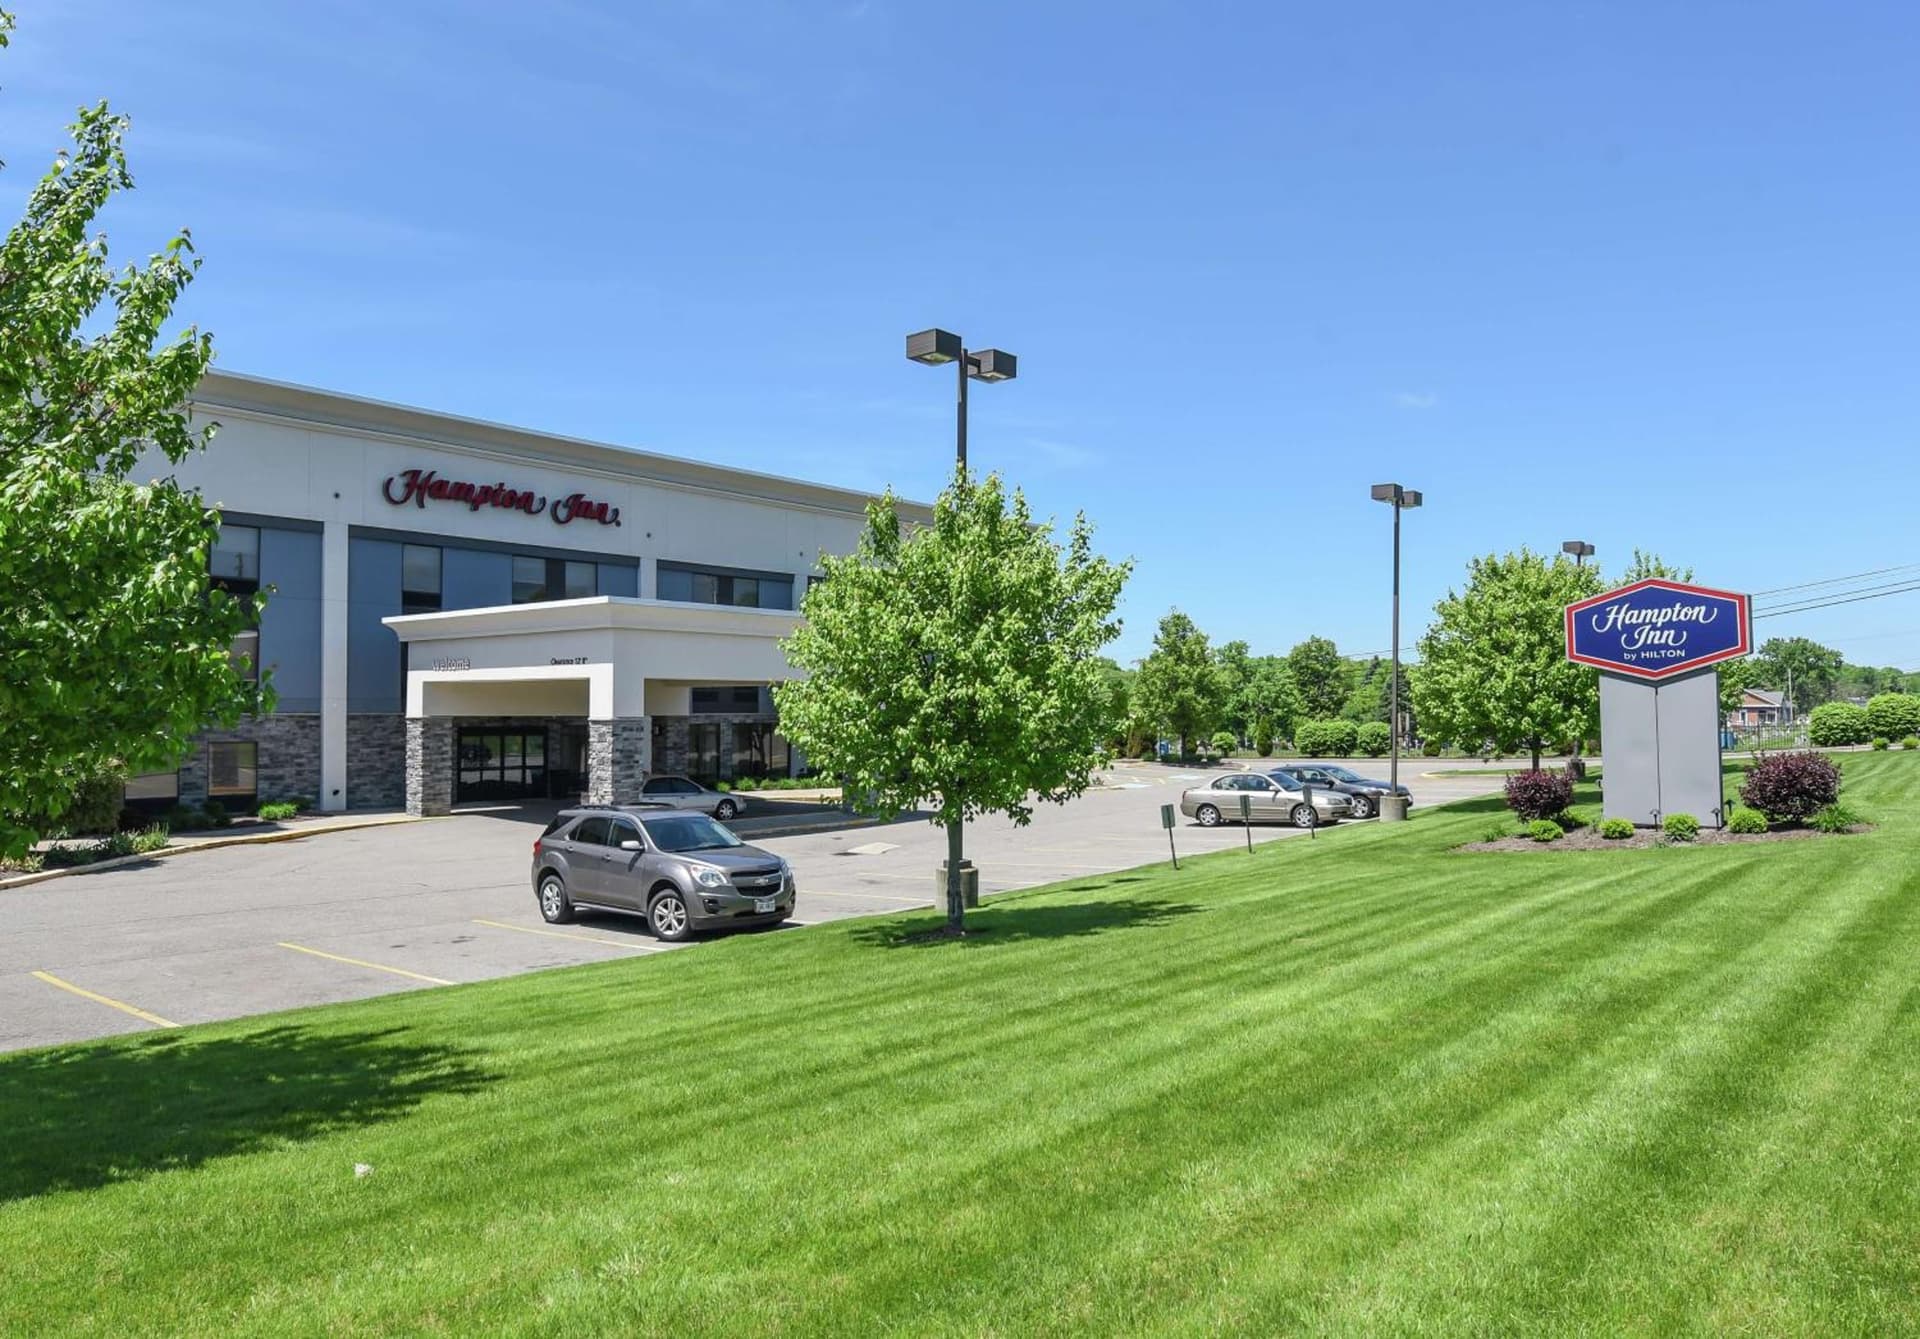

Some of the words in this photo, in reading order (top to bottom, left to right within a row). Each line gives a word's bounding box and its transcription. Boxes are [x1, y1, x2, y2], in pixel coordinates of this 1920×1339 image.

[382, 468, 546, 515] Hampton
[1592, 602, 1718, 633] Hampton
[1621, 625, 1687, 650] Inn
[1623, 652, 1637, 661] by
[1641, 649, 1686, 660] HILTON
